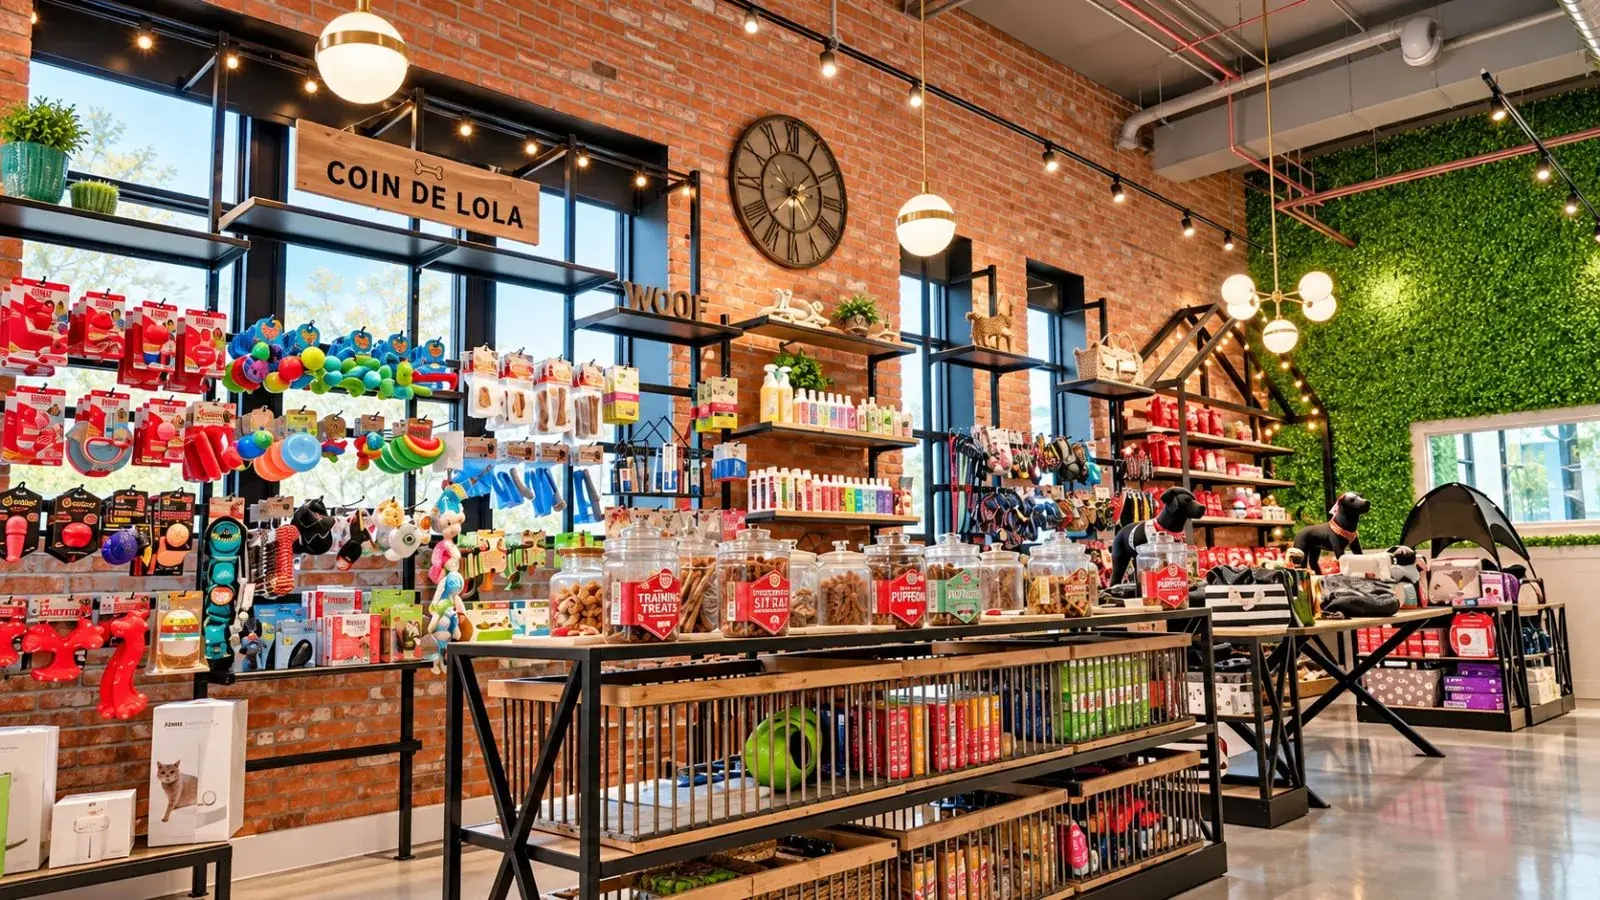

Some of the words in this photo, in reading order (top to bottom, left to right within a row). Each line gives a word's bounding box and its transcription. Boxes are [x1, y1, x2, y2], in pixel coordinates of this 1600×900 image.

[327, 160, 400, 199] COIN
[411, 180, 446, 210] DE
[457, 191, 524, 229] LOLA
[623, 281, 709, 321] WOOF
[640, 603, 678, 614] TREATS
